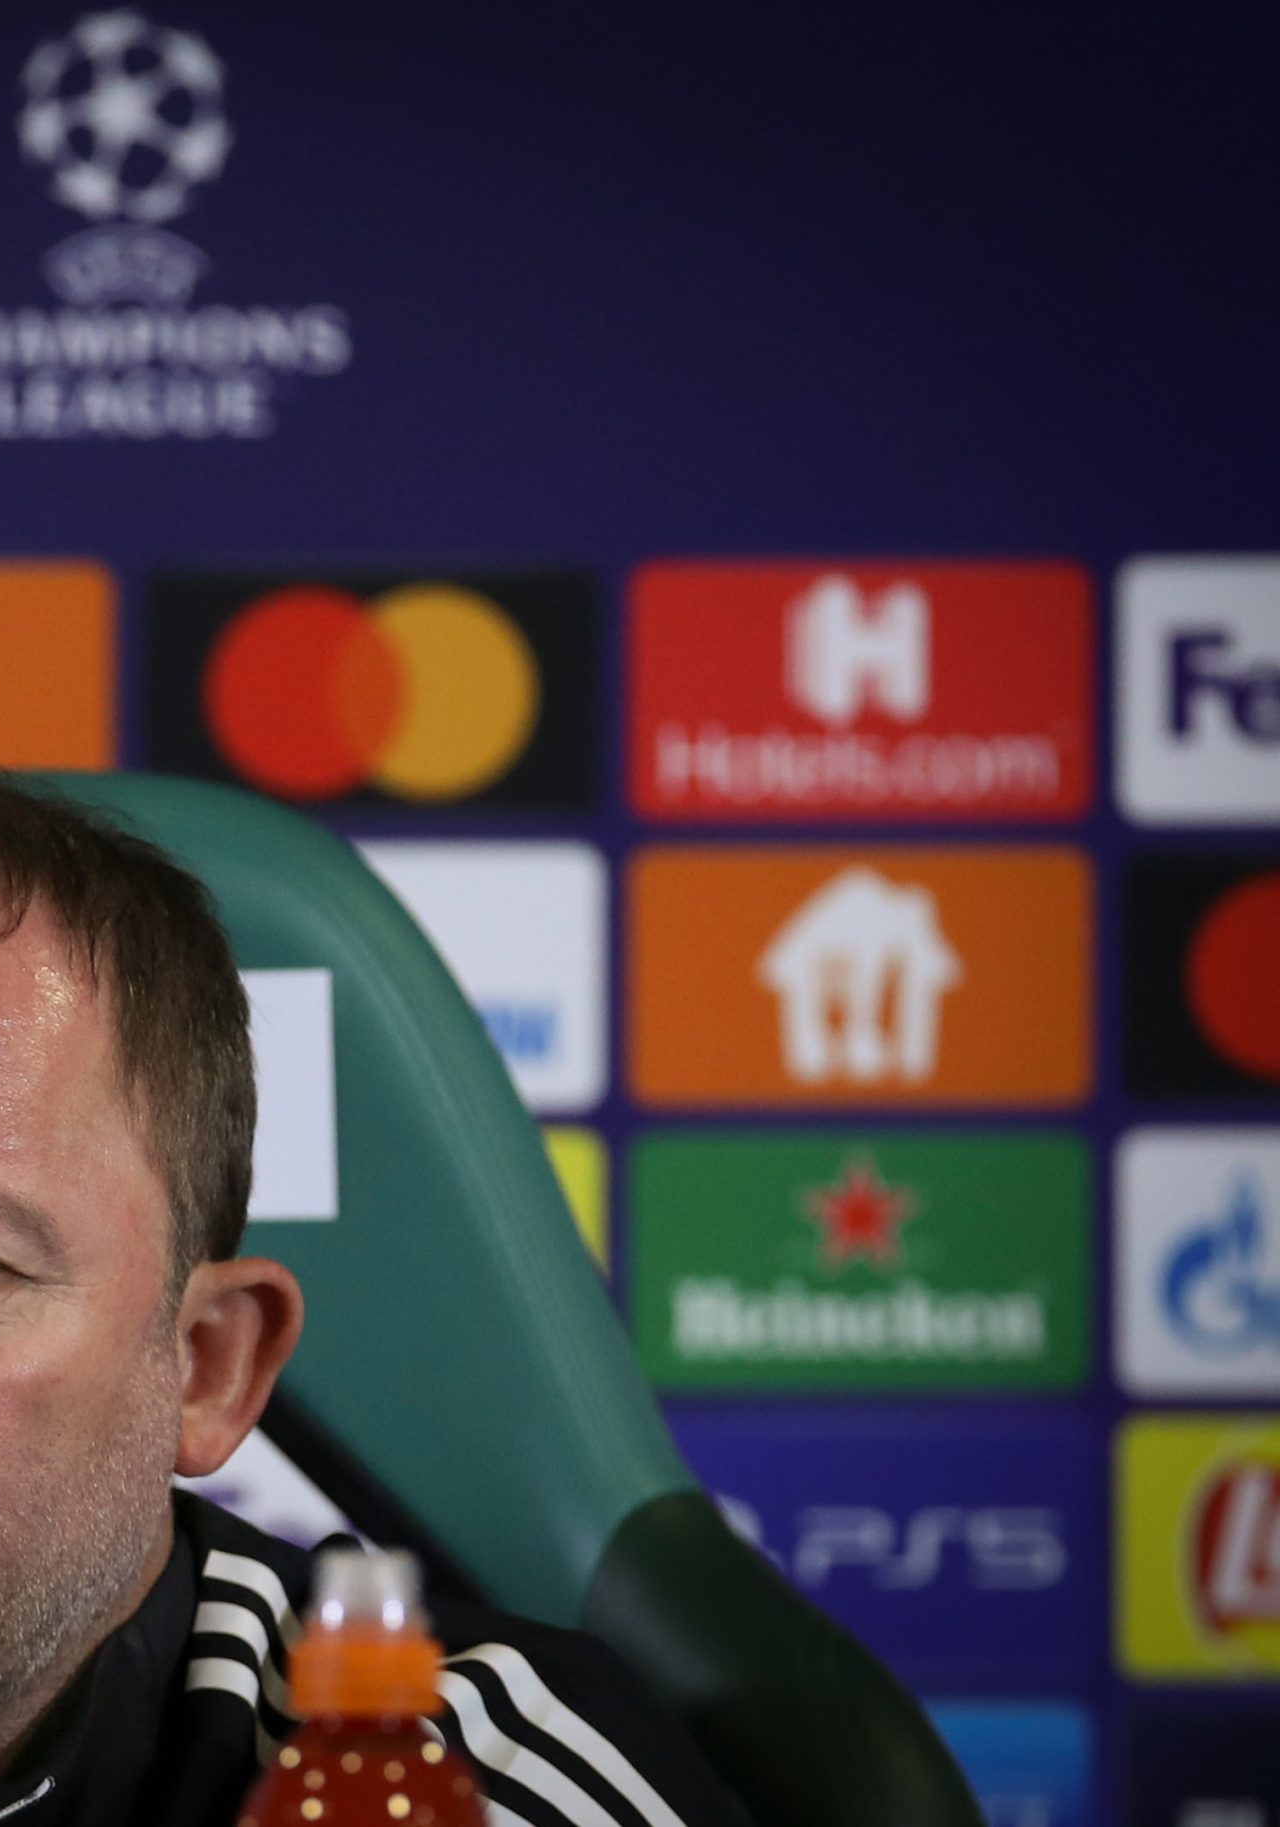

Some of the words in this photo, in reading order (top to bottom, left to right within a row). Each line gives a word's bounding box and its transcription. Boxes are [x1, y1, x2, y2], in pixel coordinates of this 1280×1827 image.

[656, 722, 1062, 800] Hotels.com
[672, 1278, 1046, 1360] Heineken
[794, 1506, 1068, 1590] PS5
